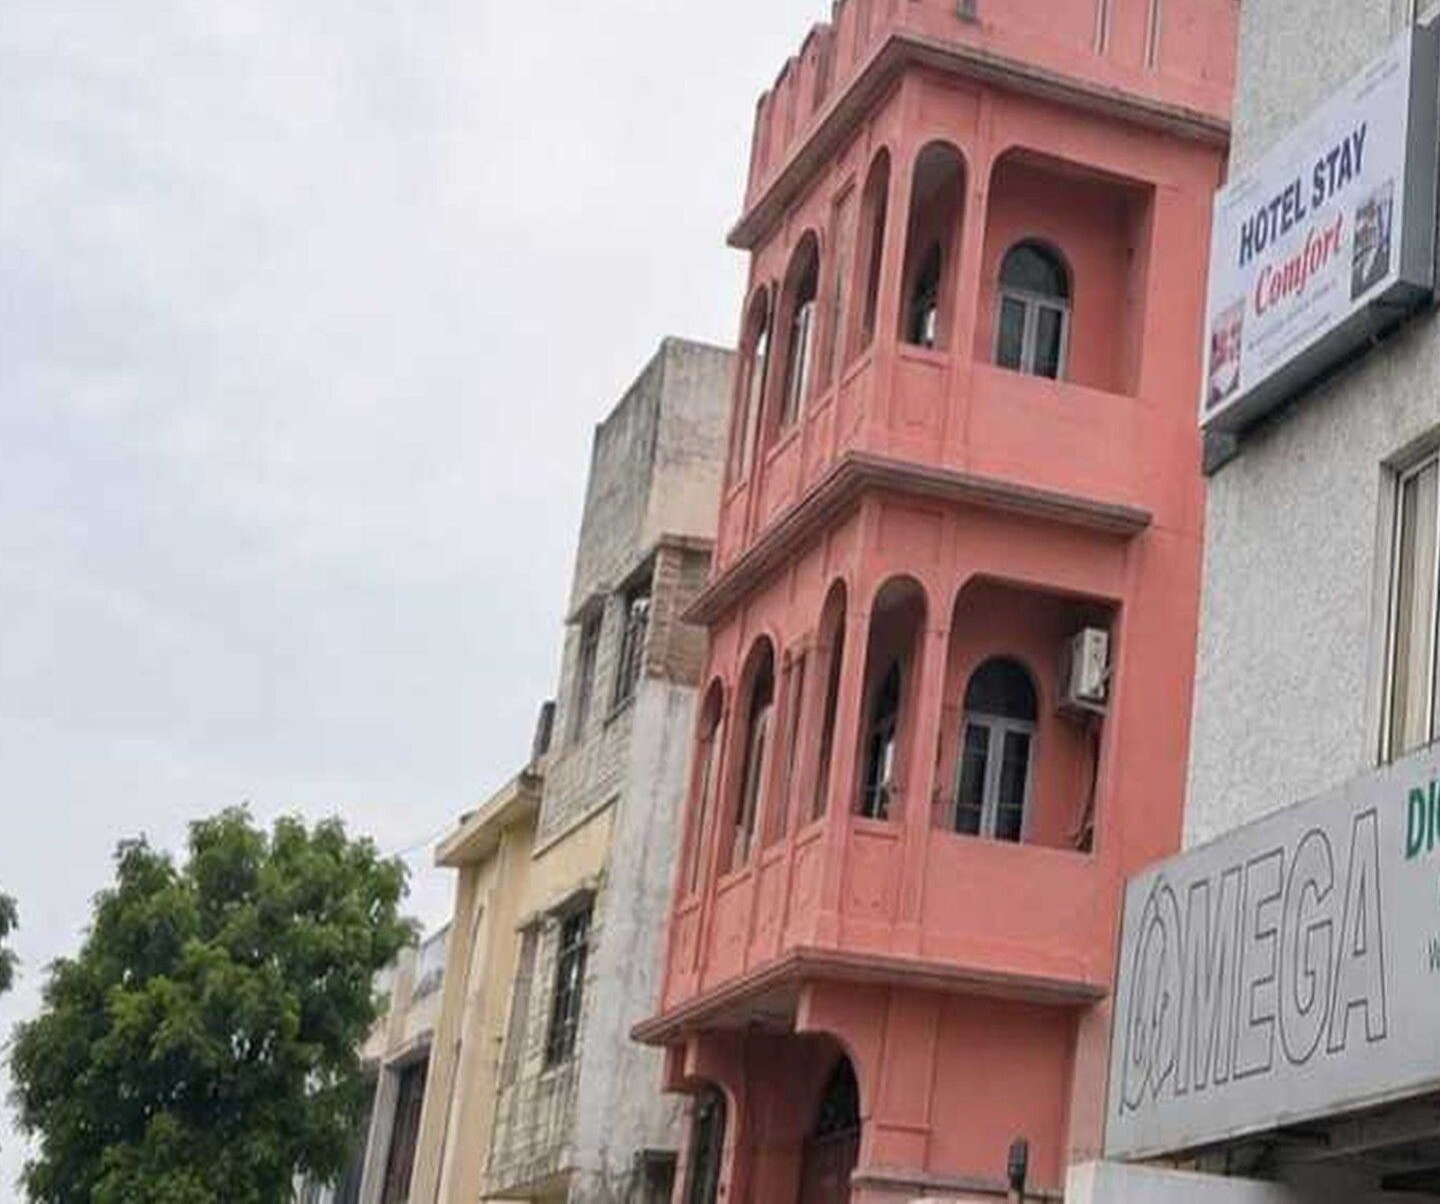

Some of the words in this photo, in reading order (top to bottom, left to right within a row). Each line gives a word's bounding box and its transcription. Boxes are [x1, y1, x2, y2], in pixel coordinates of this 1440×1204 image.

[1239, 174, 1306, 268] HOTEL
[1311, 121, 1367, 209] STAY
[1255, 211, 1344, 317] Comfort
